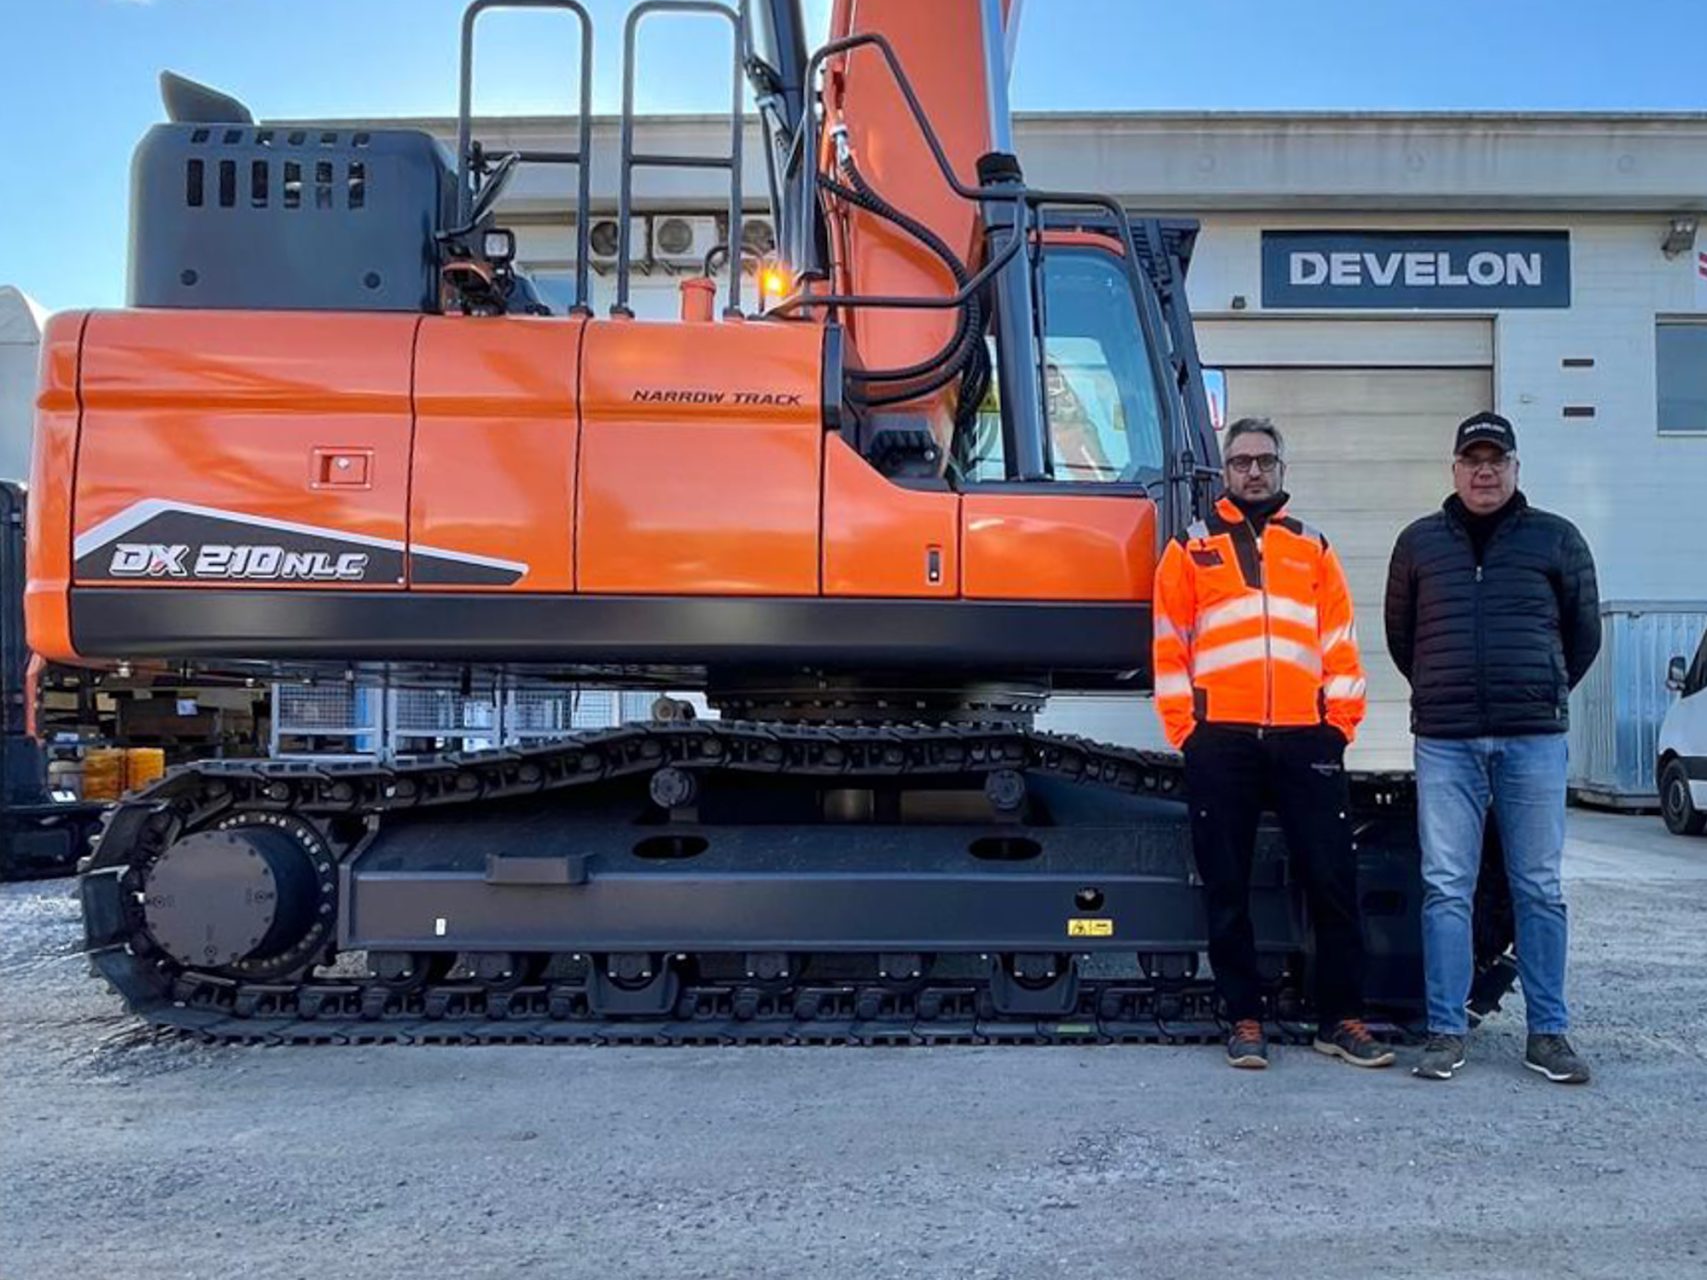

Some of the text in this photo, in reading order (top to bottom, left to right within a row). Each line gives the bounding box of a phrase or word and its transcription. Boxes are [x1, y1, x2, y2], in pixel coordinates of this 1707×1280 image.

[1289, 251, 1542, 286] DEVELON
[633, 389, 803, 406] NARROW TRACK
[109, 544, 190, 576] DX
